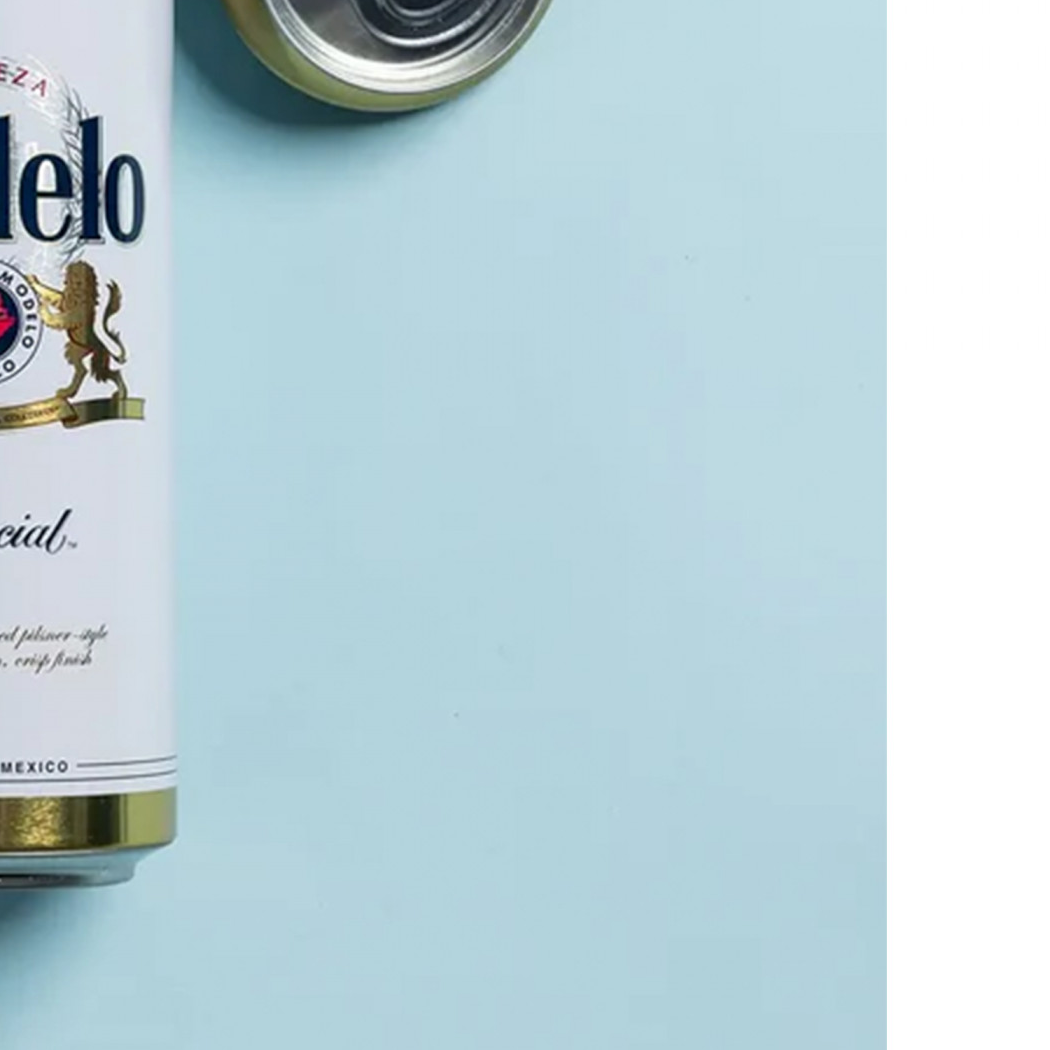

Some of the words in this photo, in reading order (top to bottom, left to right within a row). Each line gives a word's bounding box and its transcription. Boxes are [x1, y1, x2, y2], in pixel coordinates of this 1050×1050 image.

[13, 653, 52, 674] crisp
[49, 650, 93, 673] finish
[0, 760, 69, 774] MEXICO
